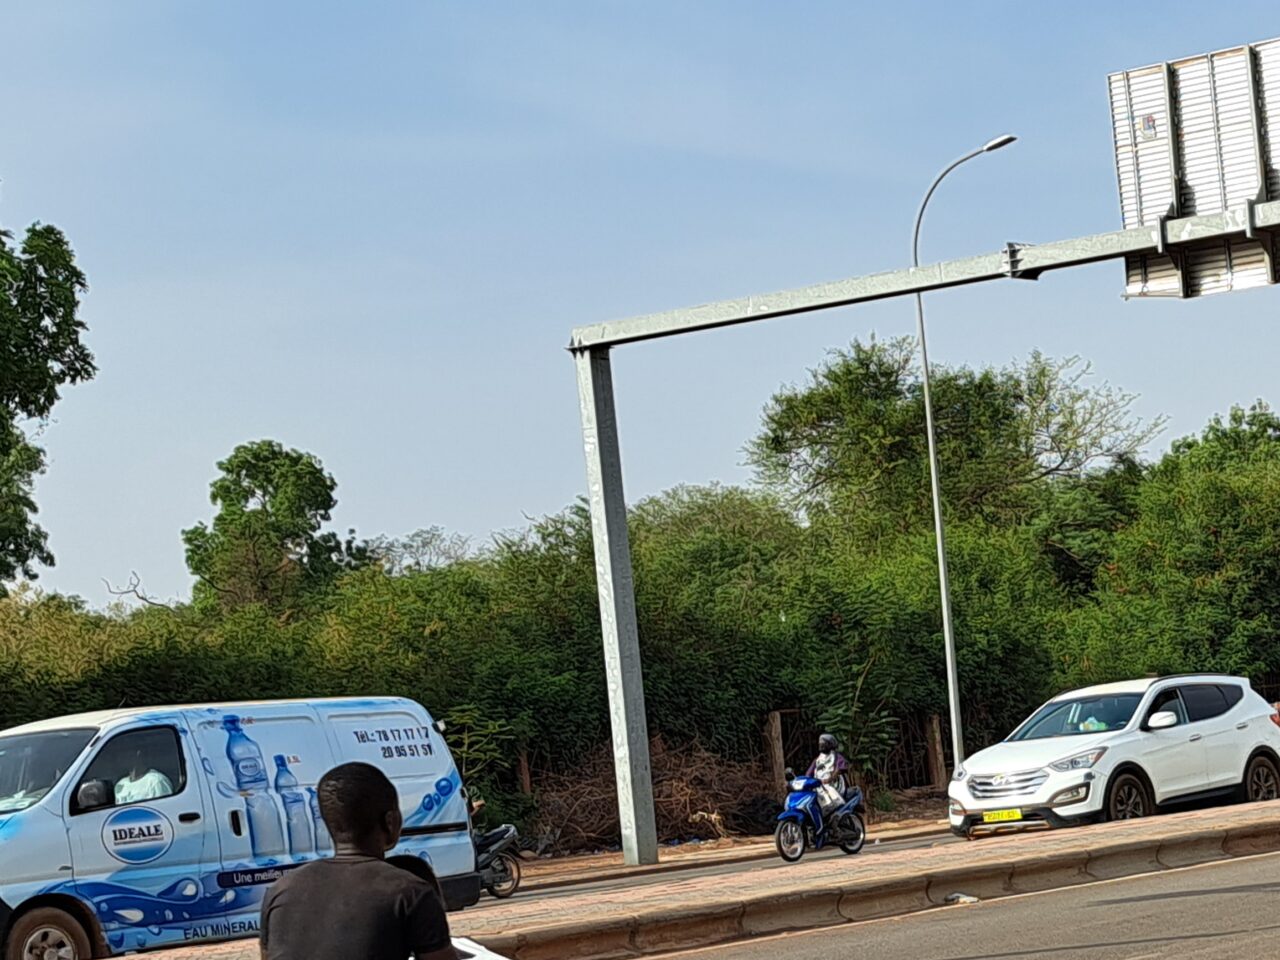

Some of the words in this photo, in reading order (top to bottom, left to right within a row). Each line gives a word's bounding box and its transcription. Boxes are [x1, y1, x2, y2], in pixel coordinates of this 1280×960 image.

[375, 730, 390, 742] 78
[390, 728, 402, 741] 17
[403, 728, 415, 740] 17
[381, 746, 394, 759] 20
[407, 744, 420, 757] 51
[112, 824, 164, 841] IDEALE
[233, 872, 253, 884] Une
[183, 926, 208, 940] EAU
[210, 920, 261, 936] MINERAL
